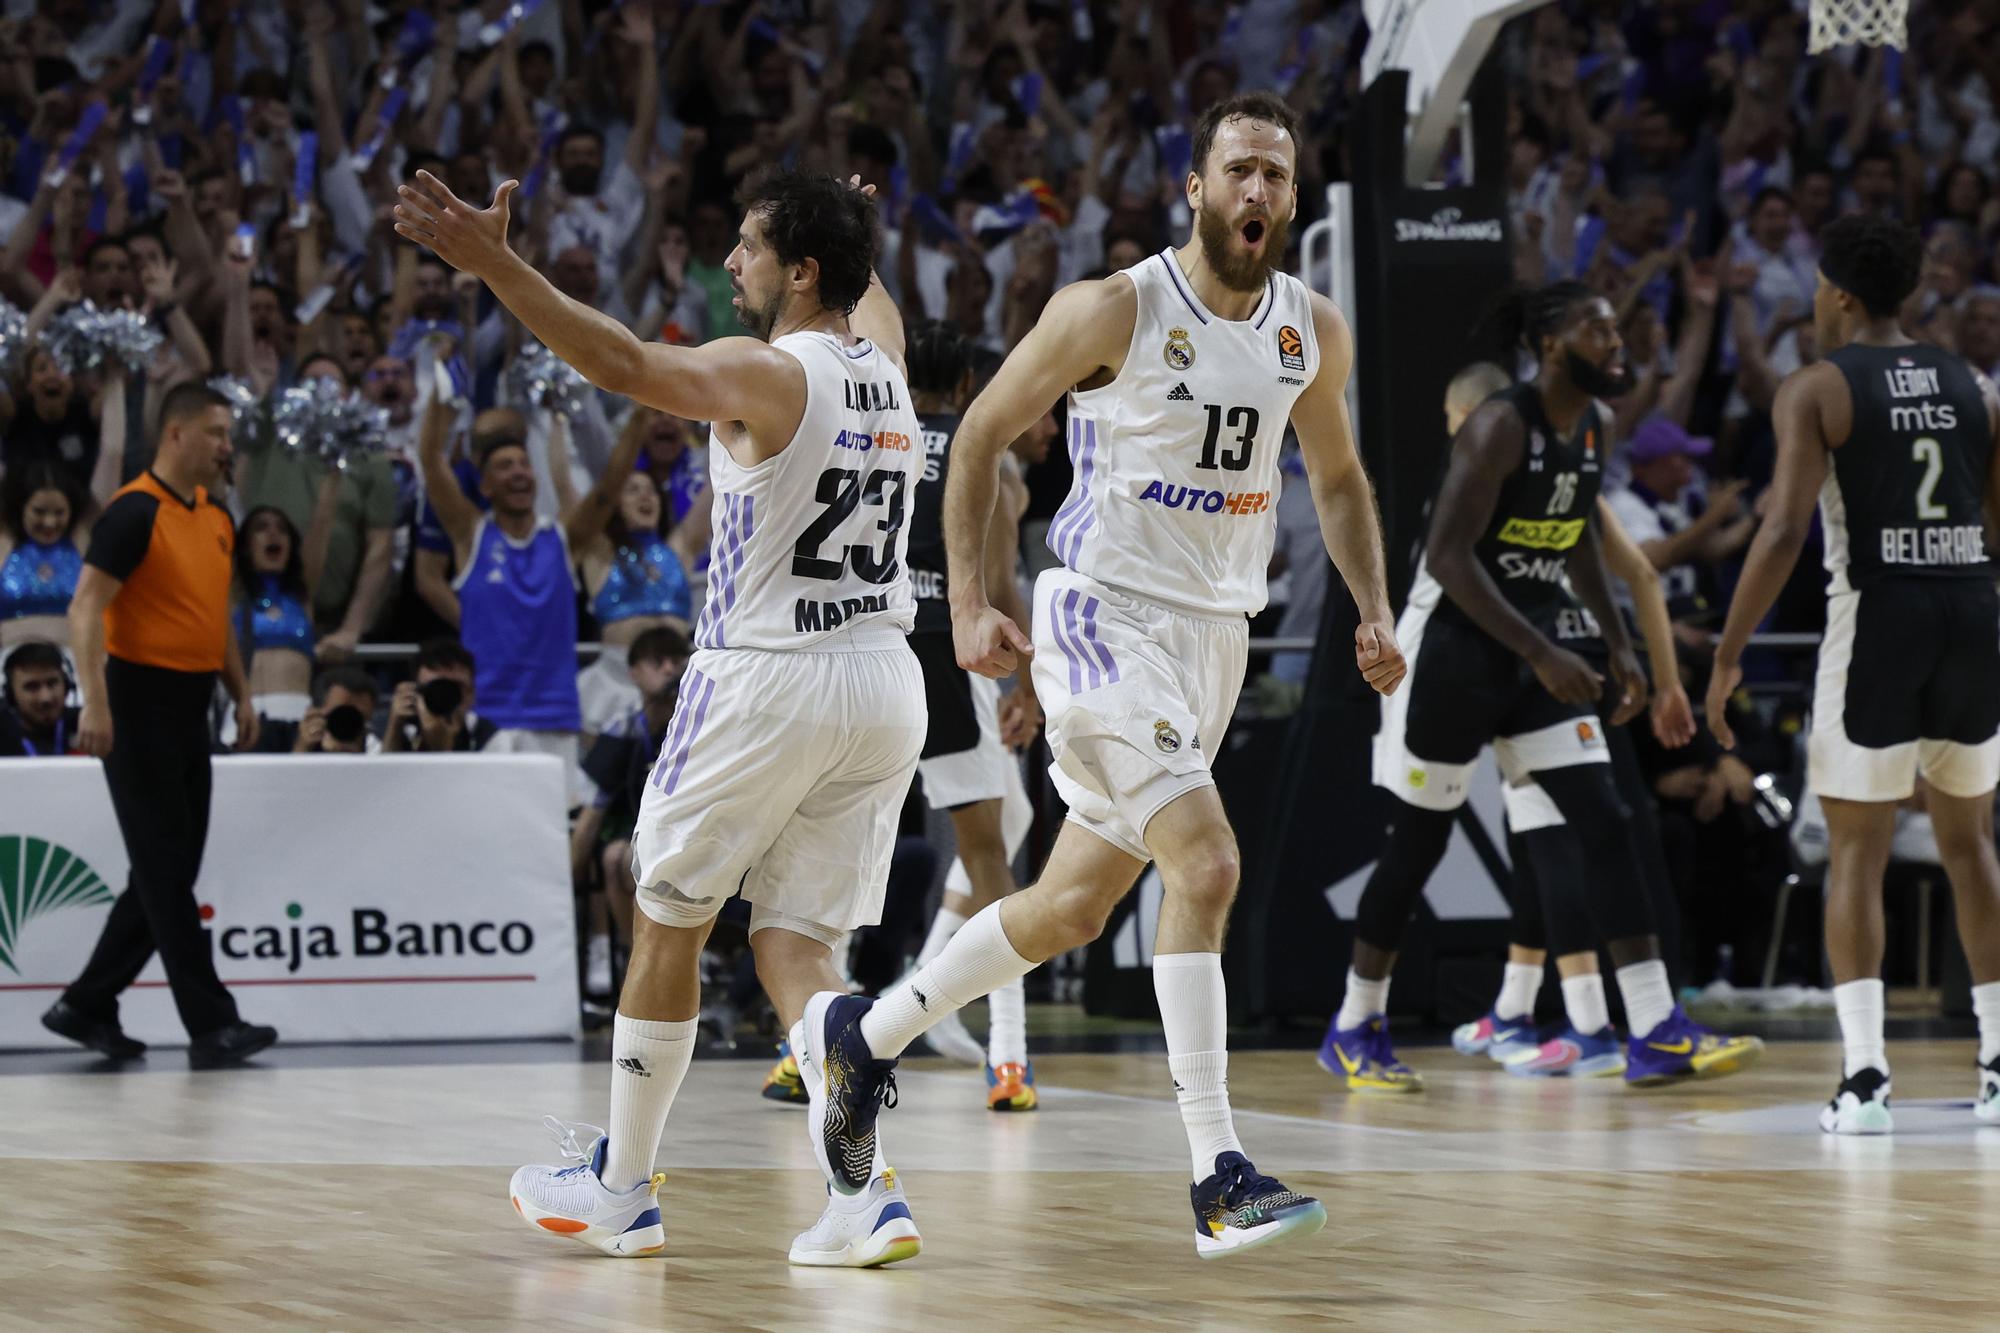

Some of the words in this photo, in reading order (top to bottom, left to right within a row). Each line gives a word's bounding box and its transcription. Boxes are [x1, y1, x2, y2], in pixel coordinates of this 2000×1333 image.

[1395, 218, 1502, 242] SPALDING
[1885, 367, 1940, 398] LEDAY
[1890, 401, 1957, 431] mts
[833, 429, 911, 452] AUTOHERO
[1195, 404, 1260, 471] 13
[1546, 471, 1579, 516] 26
[1912, 437, 1948, 520] 2
[791, 467, 906, 585] 23
[1880, 525, 1990, 566] BELGRADE
[795, 593, 889, 633] MADRI
[200, 902, 340, 974] icaja
[353, 908, 535, 957] Banco
